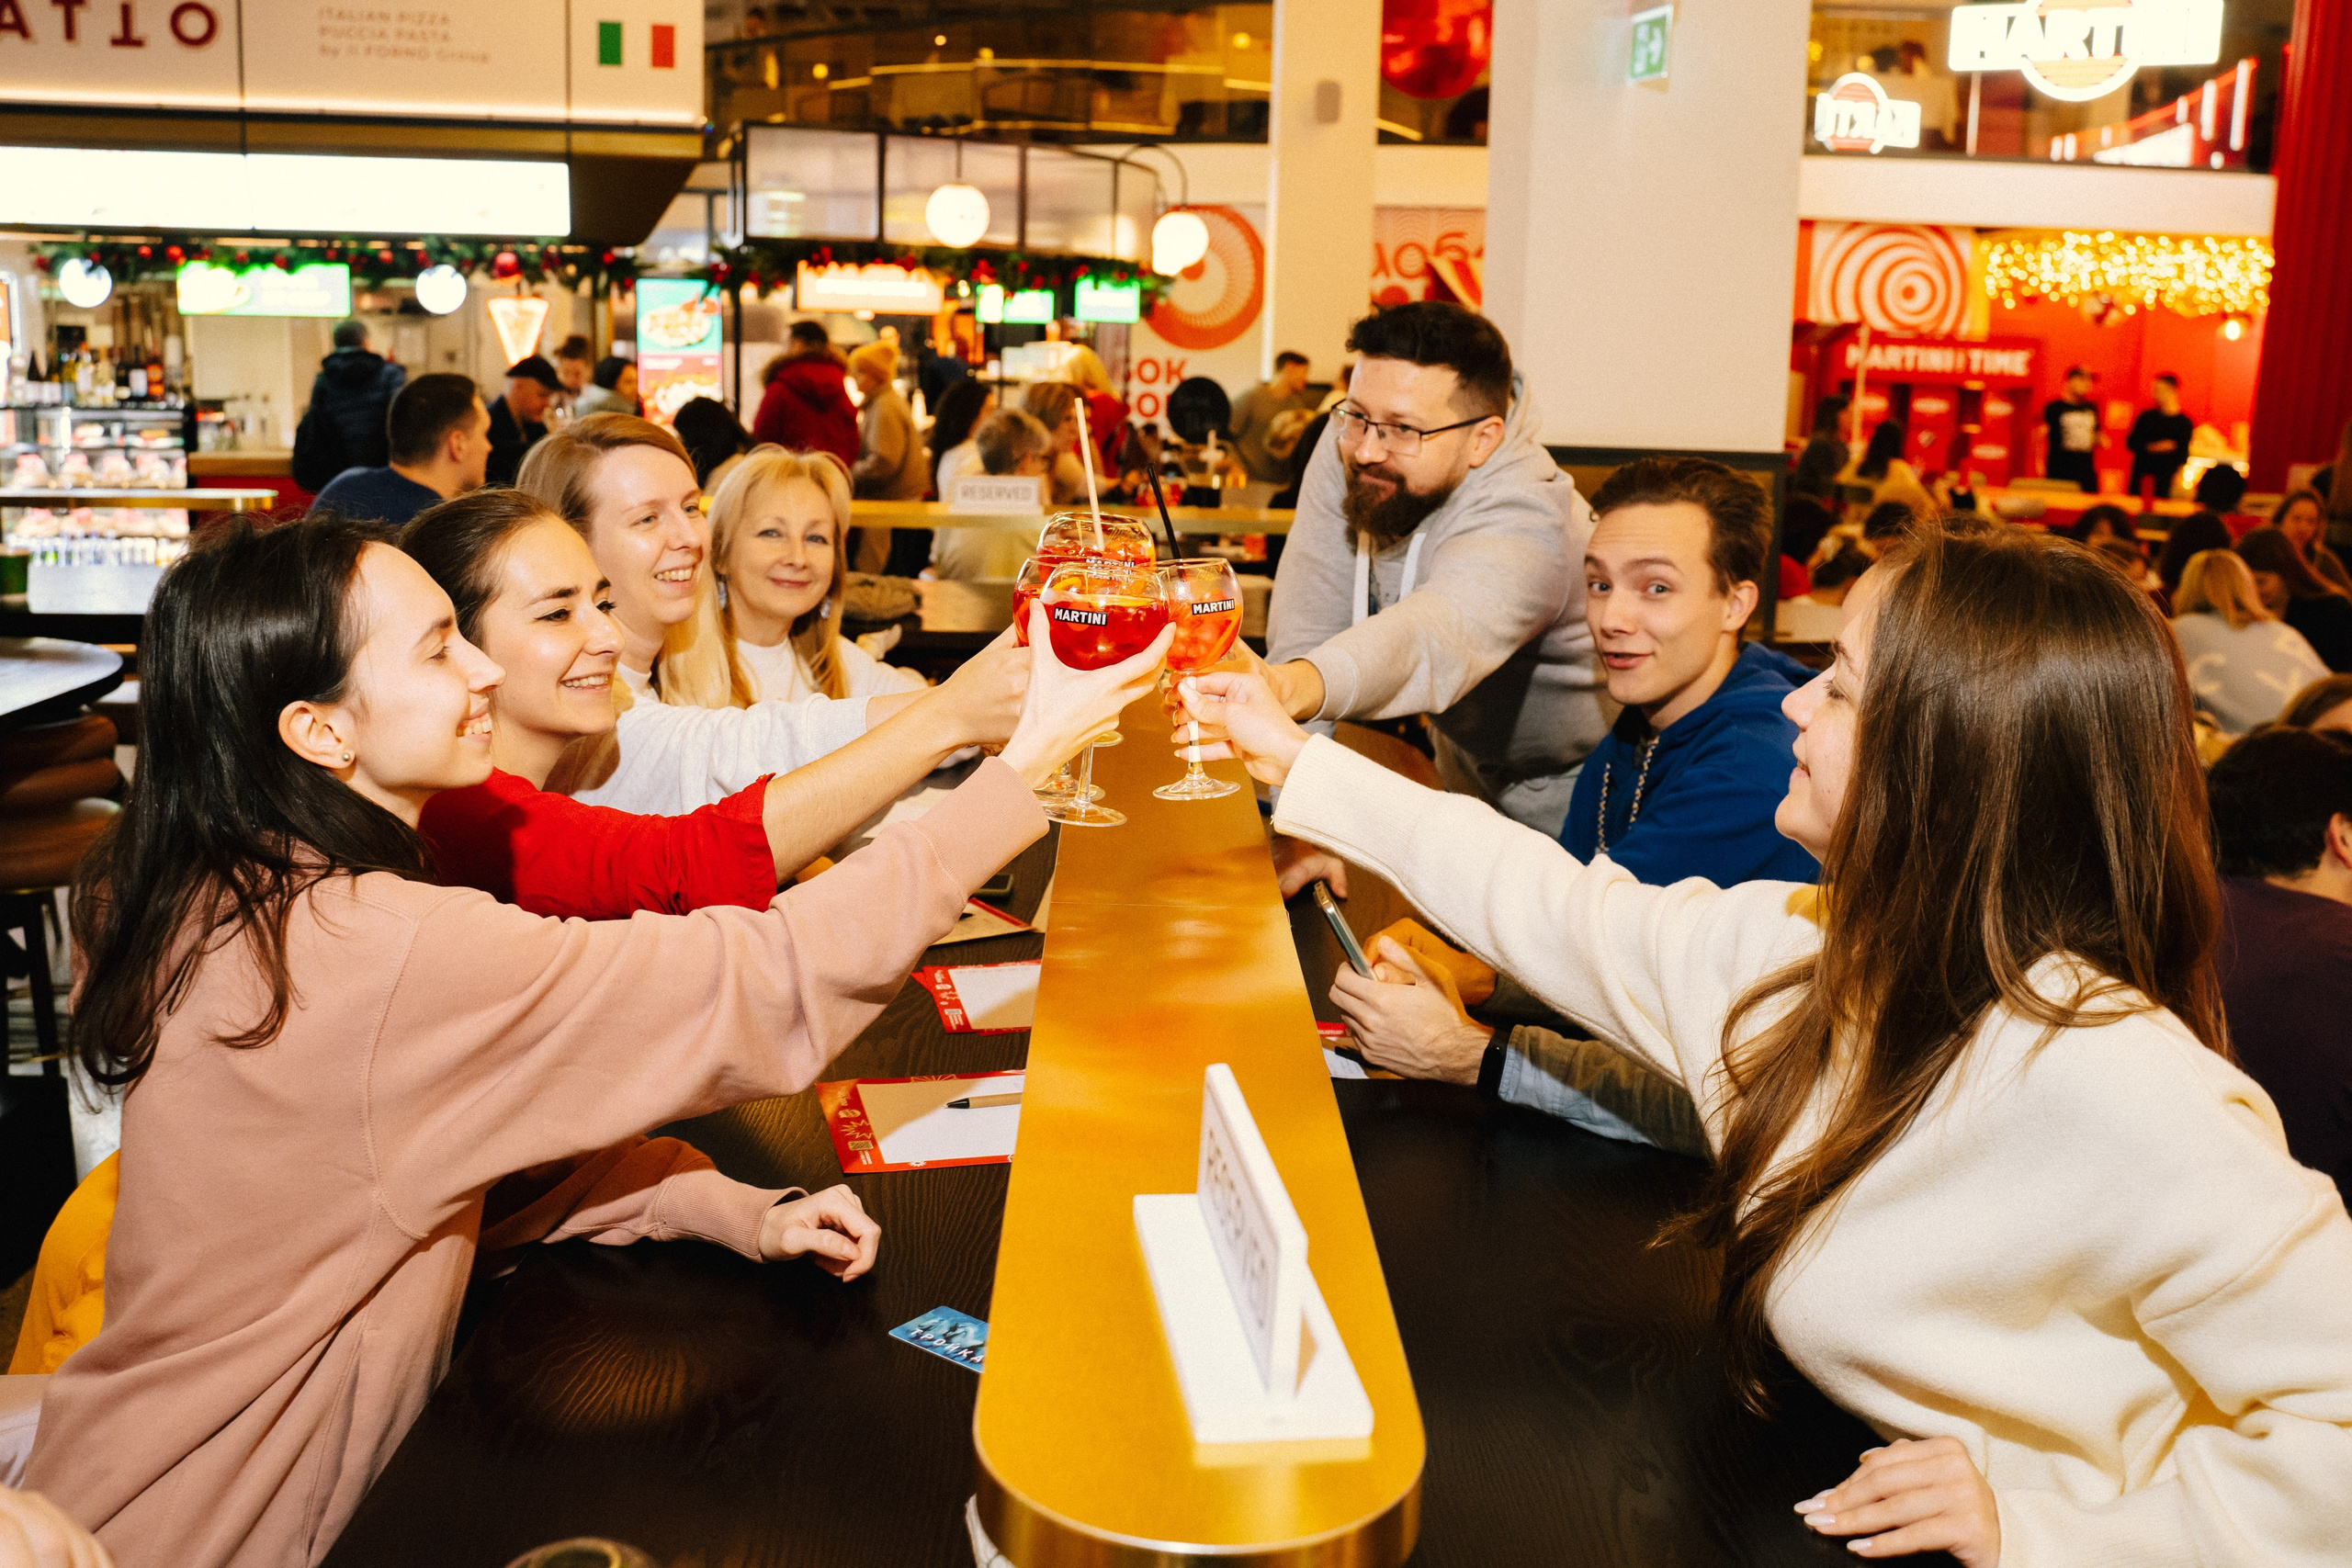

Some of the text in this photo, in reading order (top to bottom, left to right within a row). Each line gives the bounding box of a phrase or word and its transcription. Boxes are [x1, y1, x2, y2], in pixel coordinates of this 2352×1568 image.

[1054, 607, 1107, 626] MARTINI
[1193, 599, 1235, 615] MARTINI
[910, 1327, 985, 1364] ТРОЙКА
